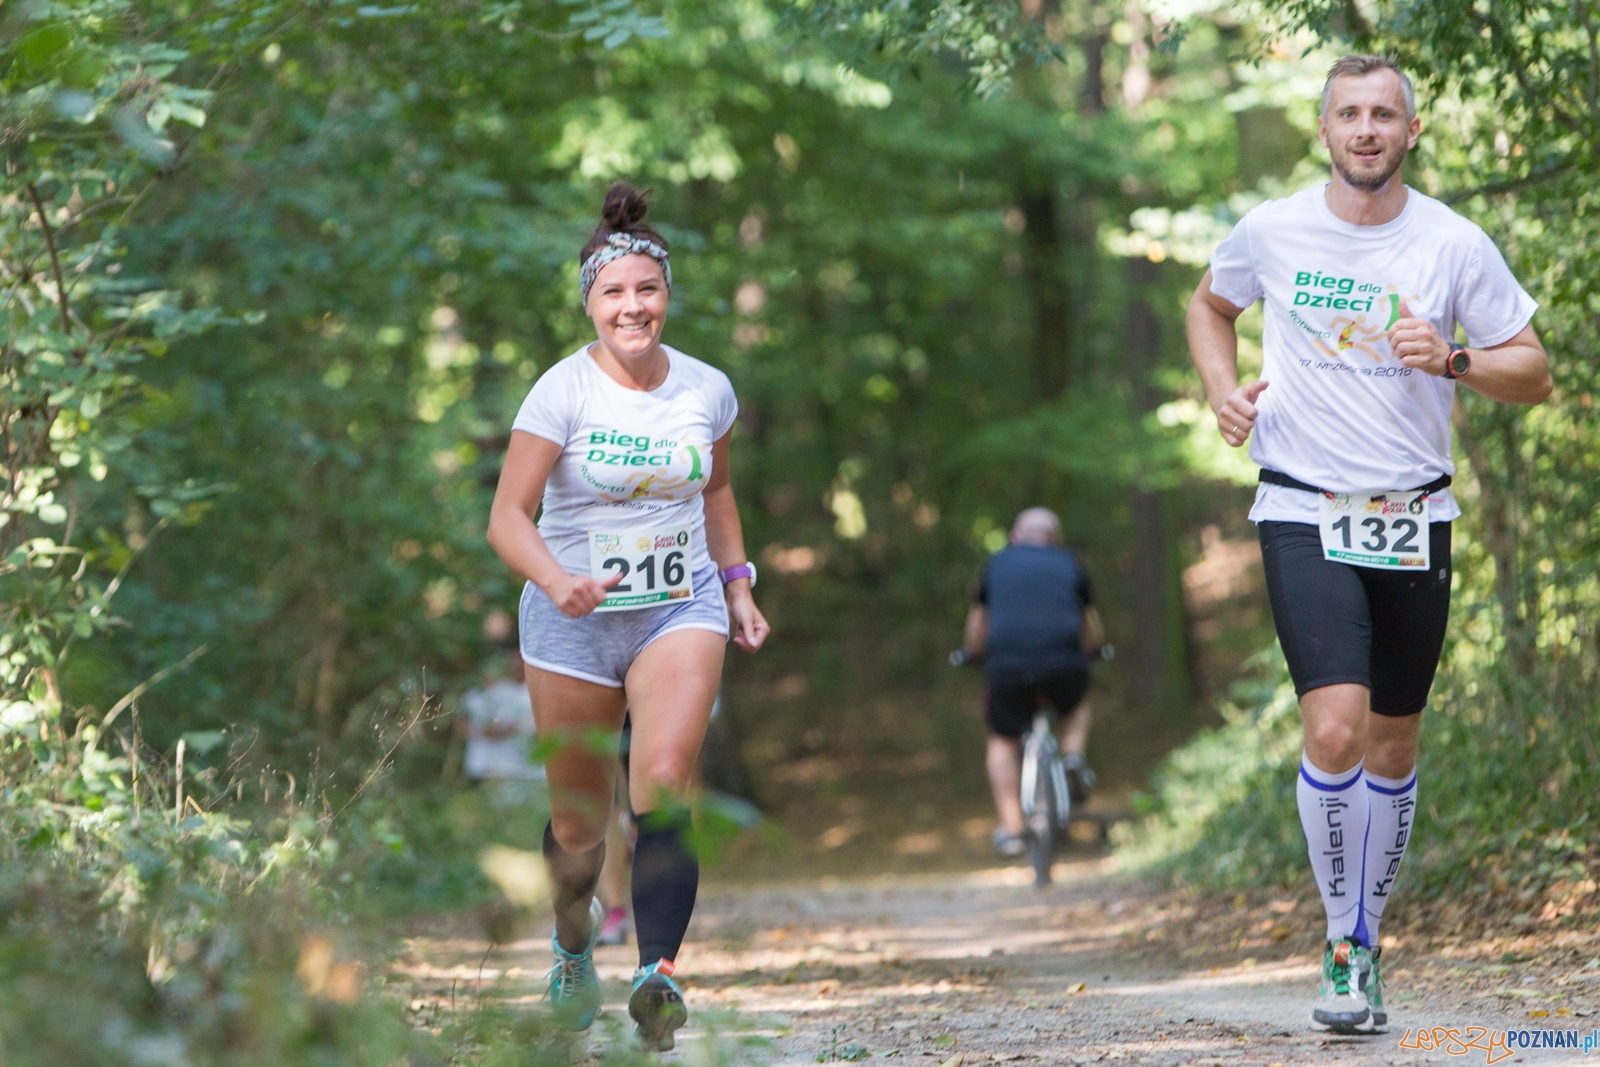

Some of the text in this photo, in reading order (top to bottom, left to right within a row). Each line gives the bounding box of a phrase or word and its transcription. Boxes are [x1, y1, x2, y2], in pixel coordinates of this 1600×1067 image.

[1294, 271, 1382, 295] Bieg dla
[1293, 291, 1374, 312] Dzieci
[589, 429, 678, 452] Bieg dla
[586, 449, 672, 466] Dzieci
[1332, 515, 1419, 553] 132
[602, 551, 685, 593] 216
